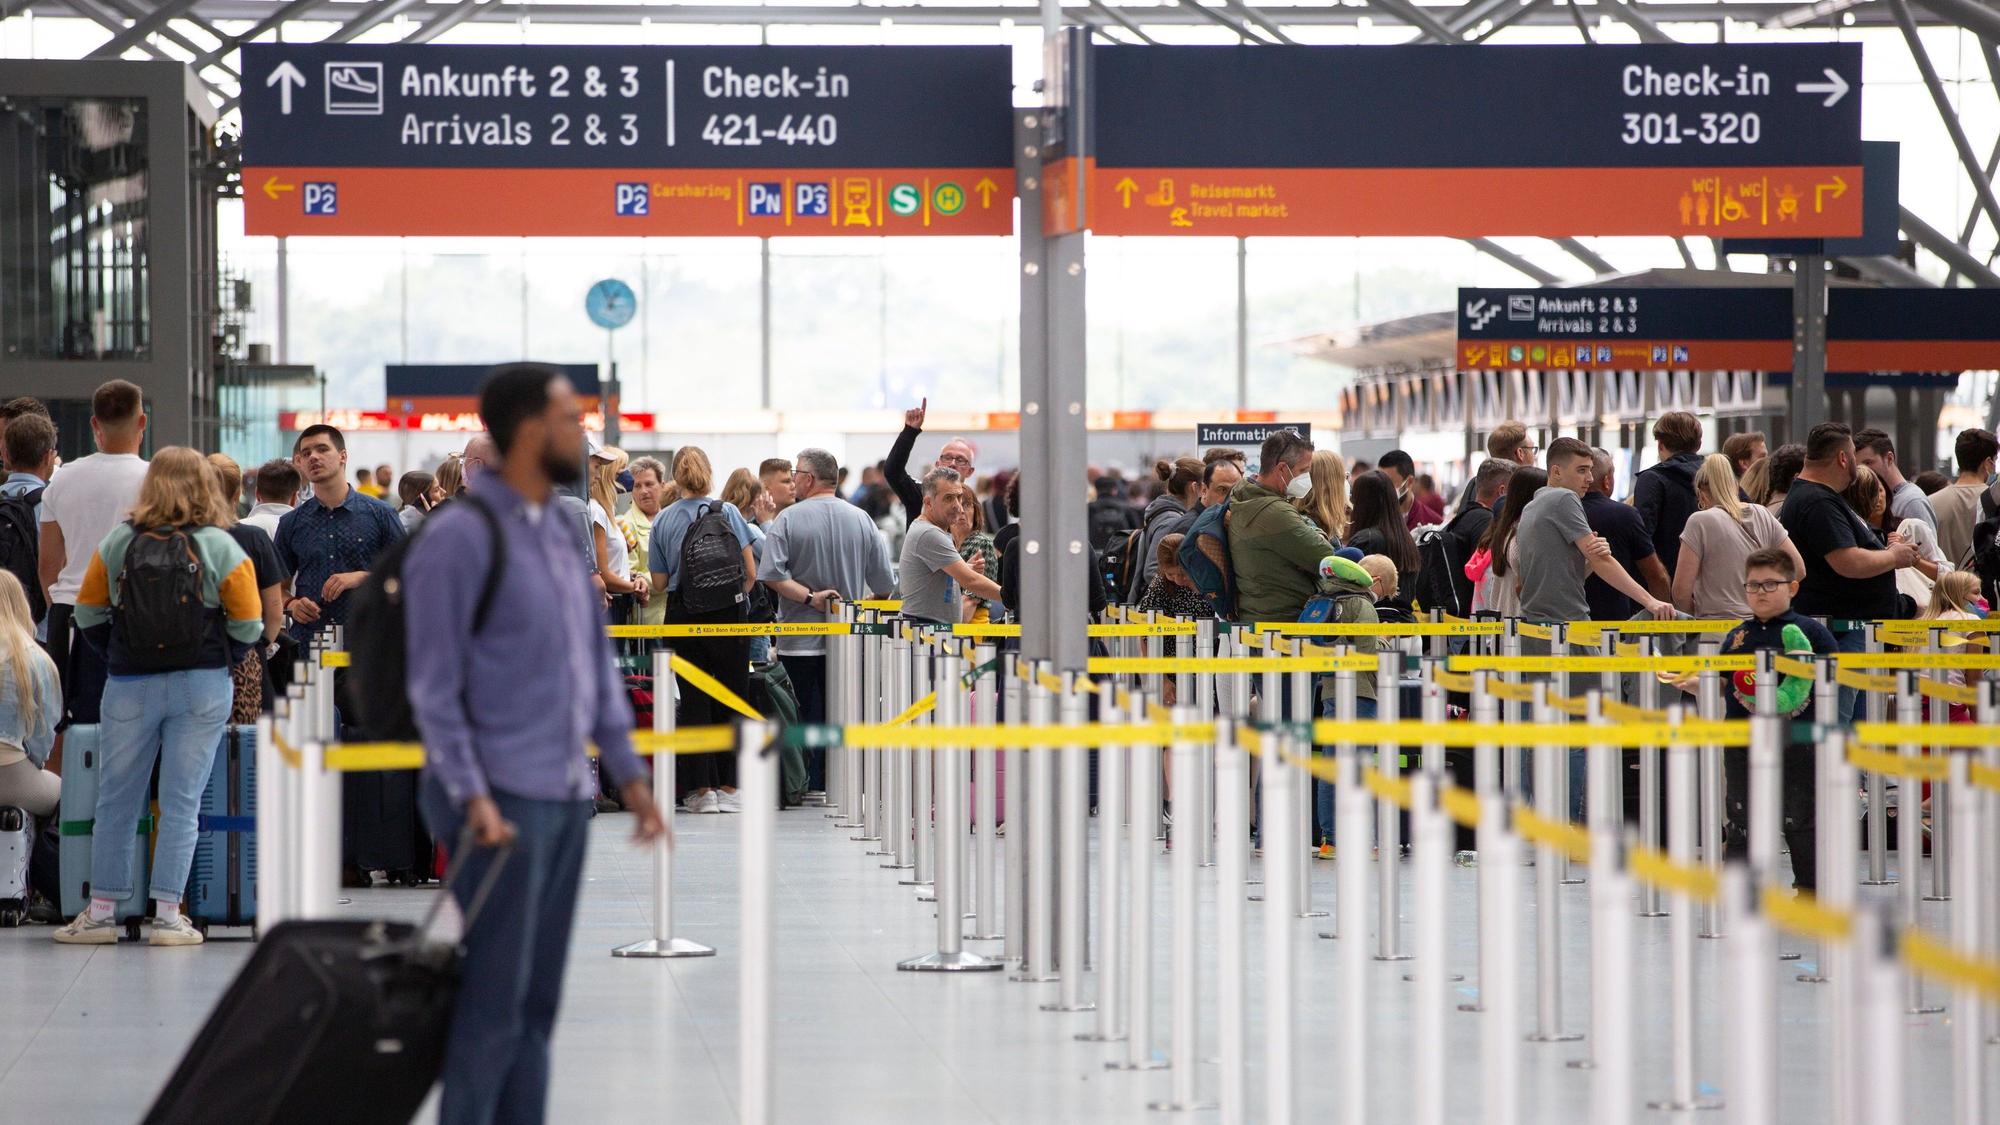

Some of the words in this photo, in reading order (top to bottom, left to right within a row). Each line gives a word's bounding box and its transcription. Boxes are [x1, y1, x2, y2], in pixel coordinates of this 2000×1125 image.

[401, 65, 536, 97] Ankunft
[549, 66, 570, 97] 2
[584, 66, 607, 97] &
[619, 66, 639, 97] 3
[703, 65, 849, 97] Check-in
[1622, 65, 1770, 97] Check-in
[401, 114, 532, 146] Arrivals
[550, 114, 570, 146] 2
[584, 114, 607, 146] &
[619, 114, 639, 146] 3
[702, 114, 837, 146] 421-440
[1621, 113, 1760, 145] 301-320
[653, 184, 732, 200] Carsharing
[1190, 184, 1276, 199] Reisemarkt
[1692, 179, 1713, 193] WC
[1739, 183, 1761, 197] WC
[1190, 202, 1233, 218] Travel
[1236, 203, 1288, 218] market
[1538, 297, 1595, 313] Ankunft
[1598, 297, 1609, 313] 2
[1613, 297, 1625, 313] &
[1628, 297, 1638, 313] 3
[1538, 317, 1593, 333] Arrivals
[1598, 317, 1609, 333] 2
[1613, 317, 1625, 333] &
[1628, 317, 1638, 333] 3
[730, 626, 748, 634] Airport
[810, 625, 829, 634] Airport
